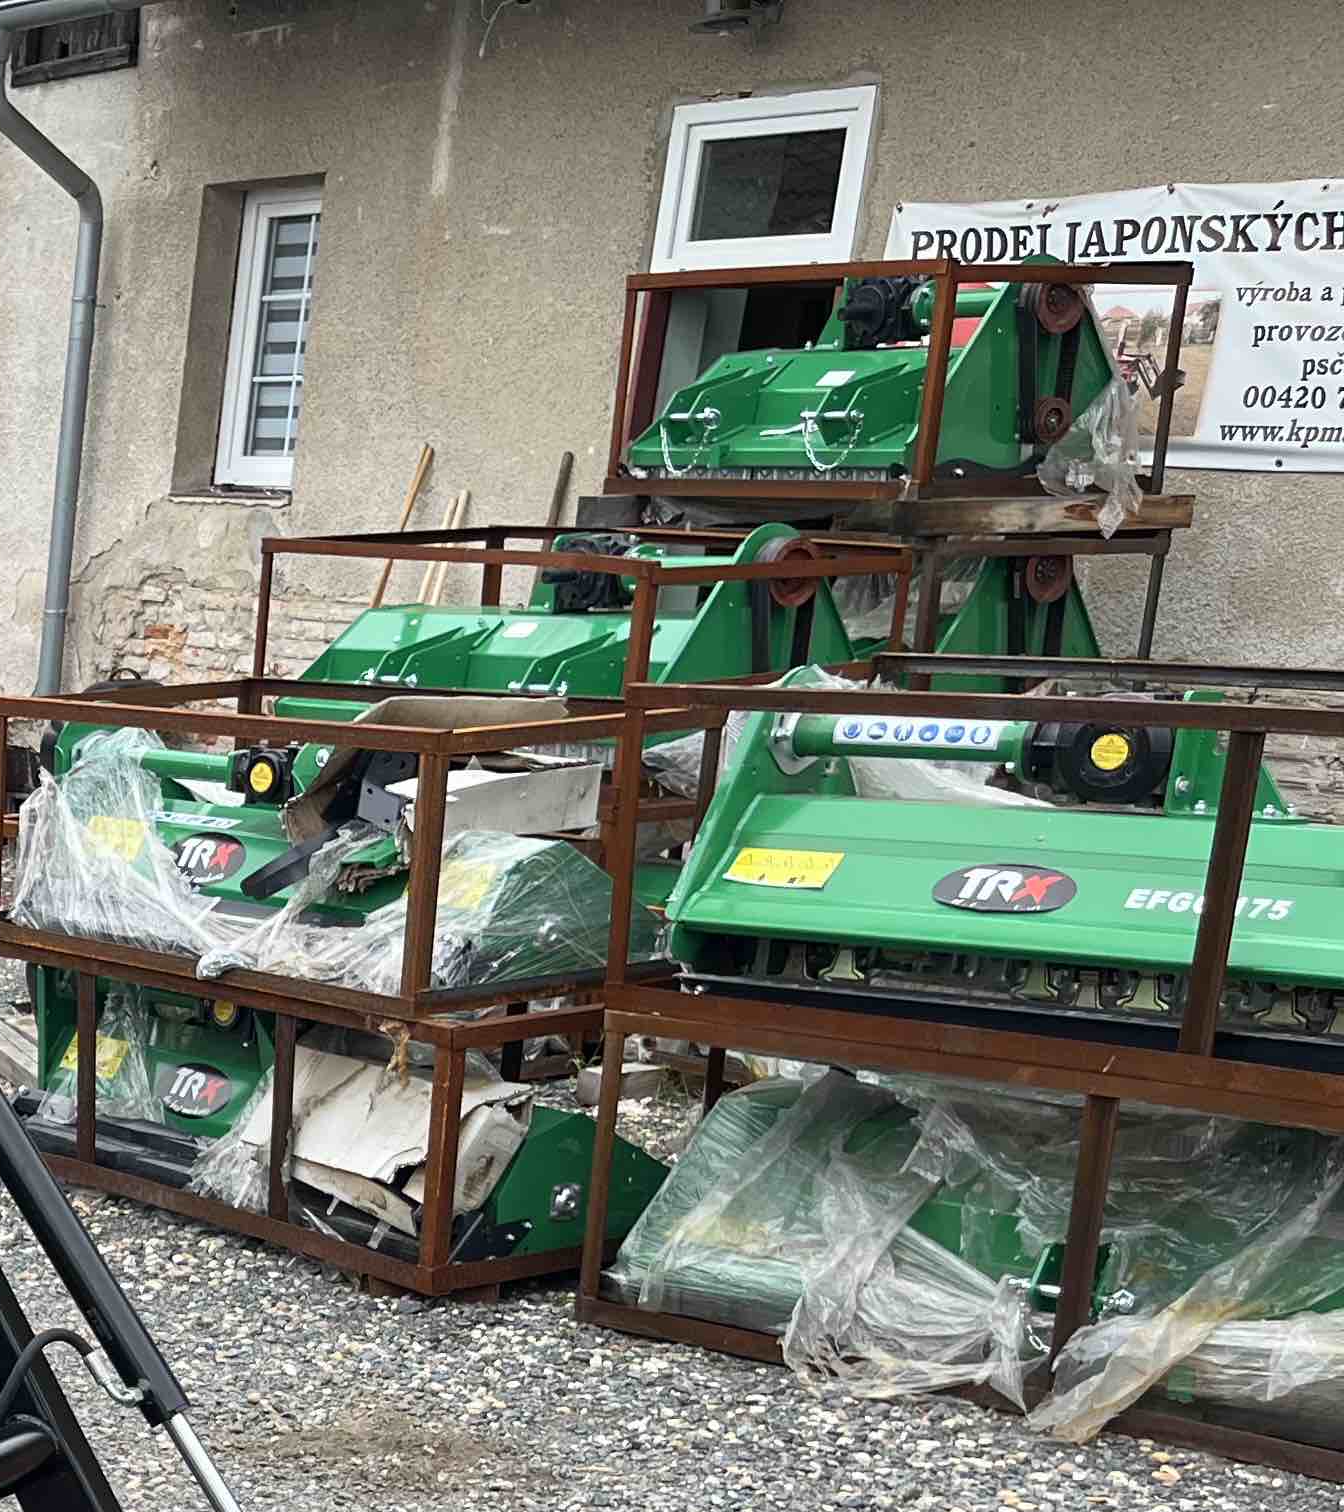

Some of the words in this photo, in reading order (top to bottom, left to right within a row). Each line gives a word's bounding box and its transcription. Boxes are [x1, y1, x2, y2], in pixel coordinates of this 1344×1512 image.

[1236, 281, 1312, 307] výroba
[1321, 286, 1333, 301] a
[1252, 324, 1344, 347] provoz
[1243, 385, 1326, 409] 00420
[1219, 418, 1344, 448] www.kpm
[177, 838, 241, 870] TRX
[957, 867, 1066, 904] TRX
[169, 1066, 226, 1105] TRX
